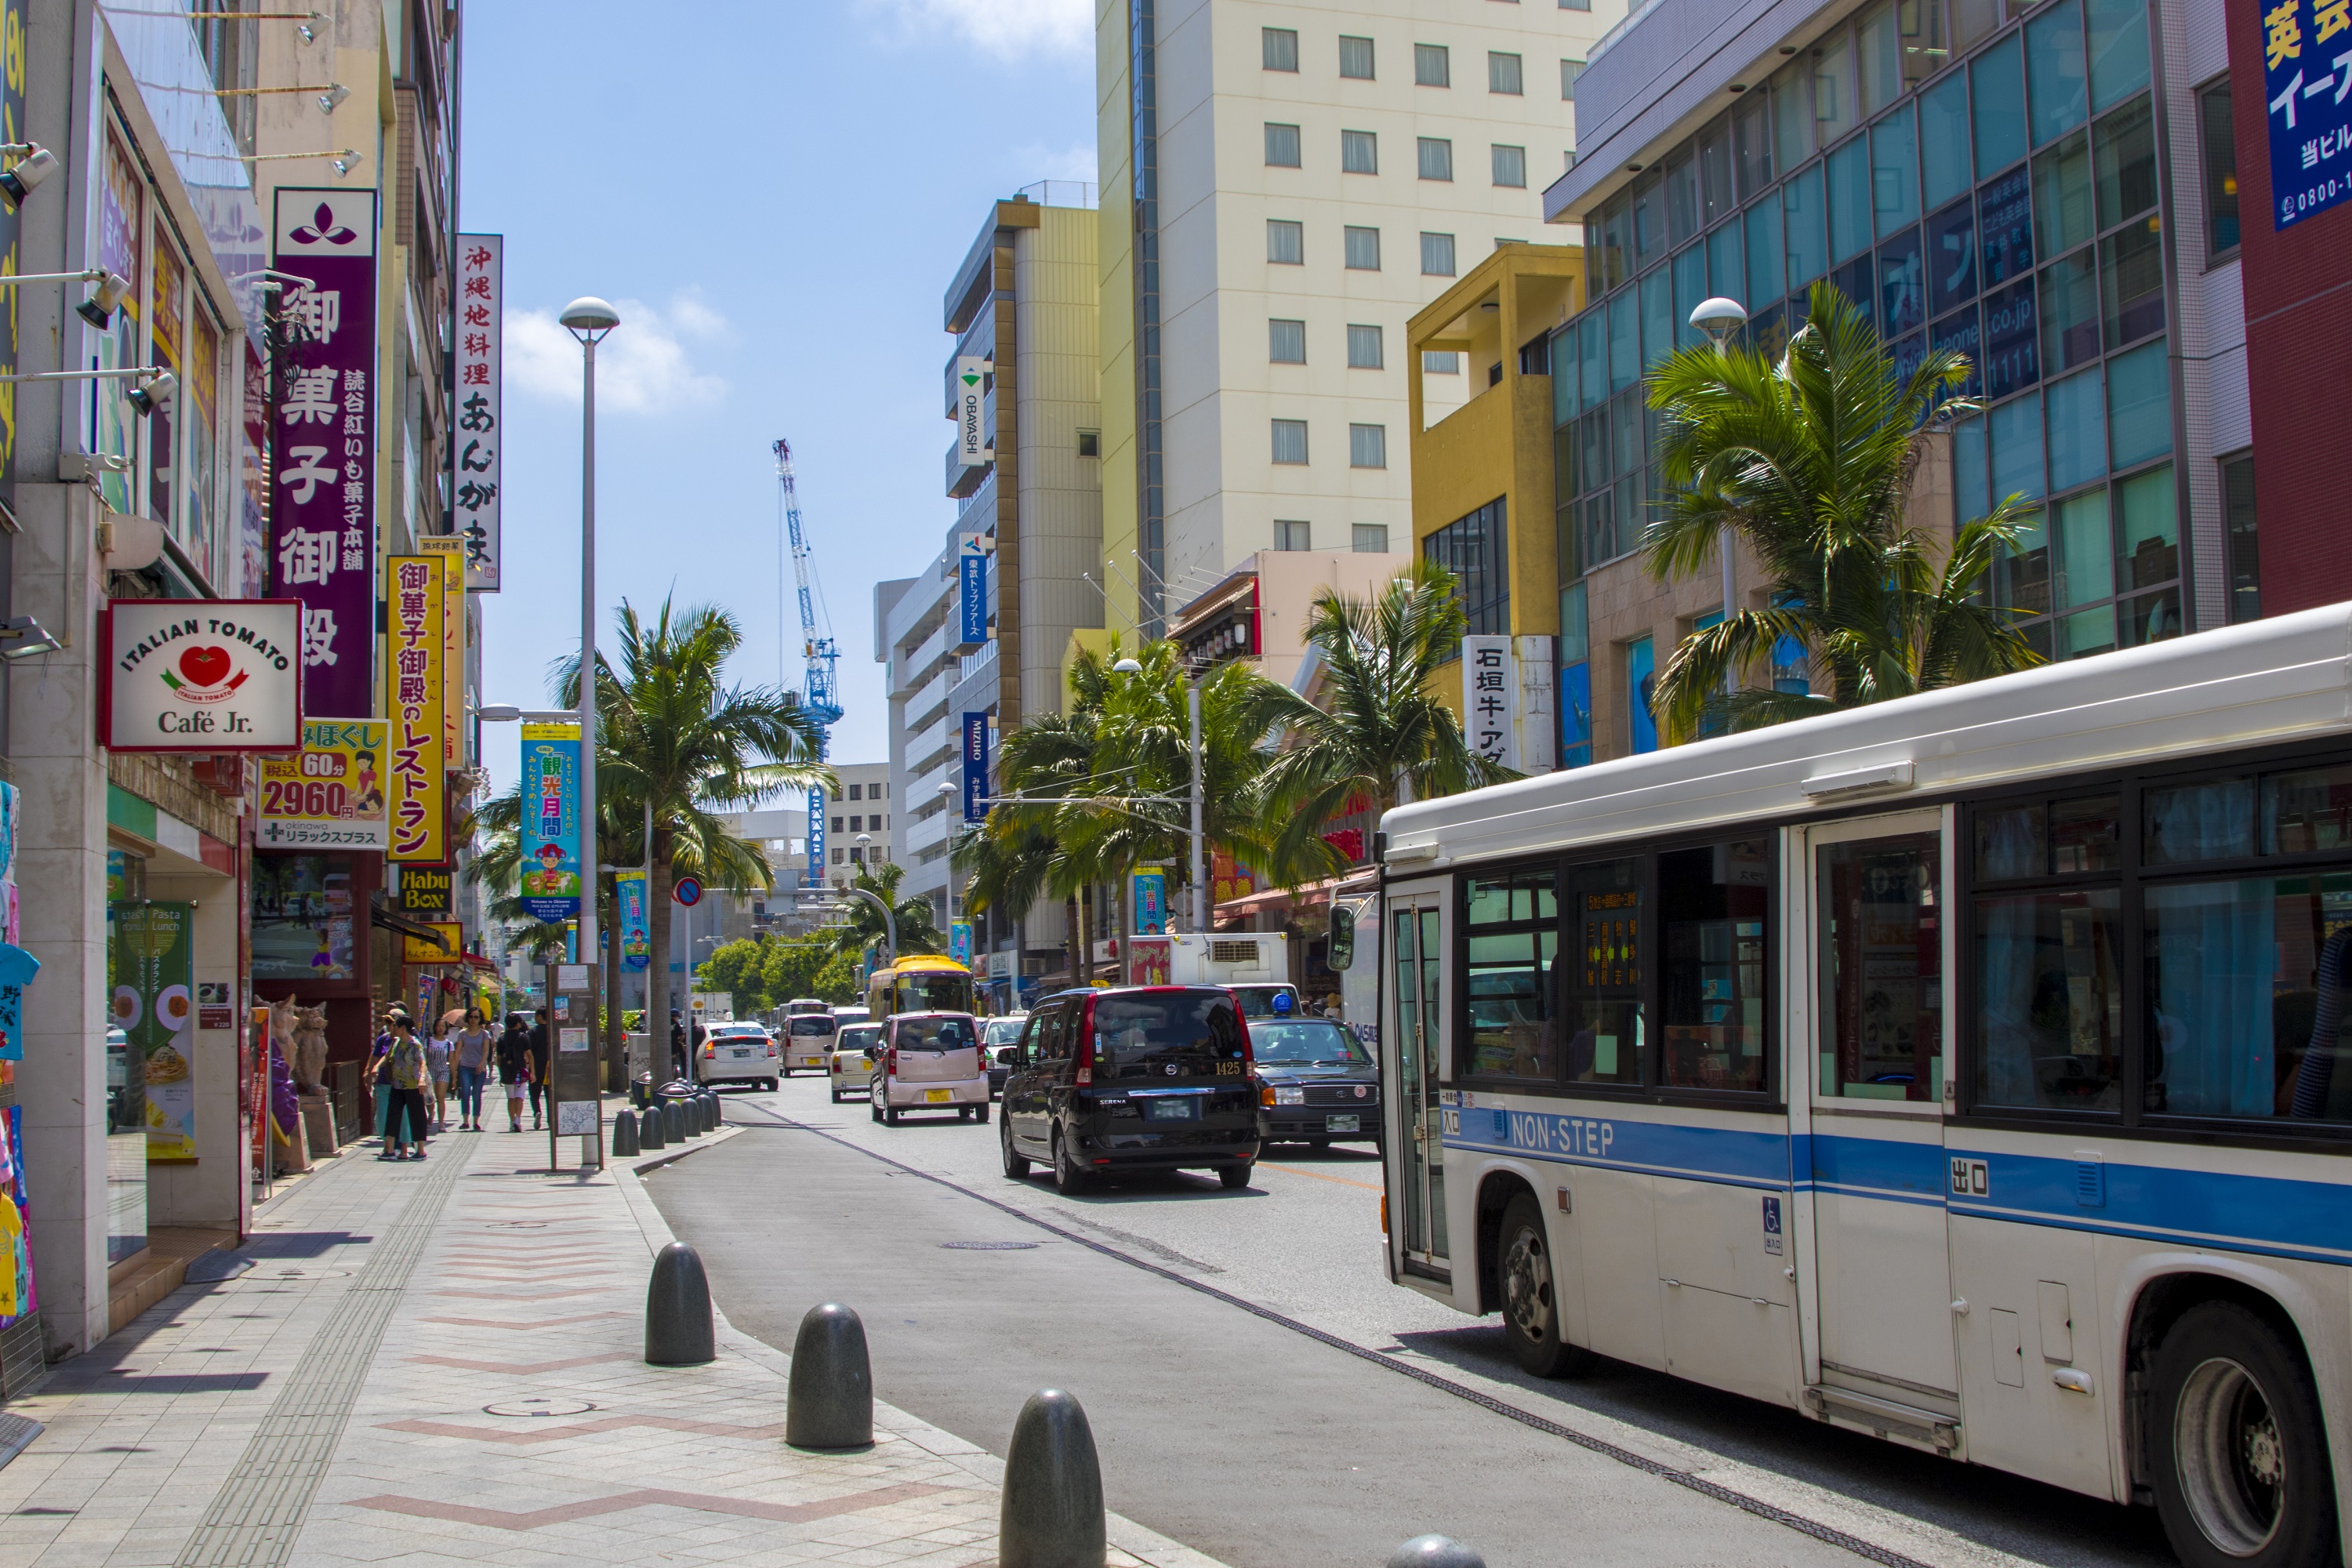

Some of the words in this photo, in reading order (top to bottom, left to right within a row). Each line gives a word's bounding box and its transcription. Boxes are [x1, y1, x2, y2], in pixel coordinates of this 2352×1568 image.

[463, 245, 493, 386] 沖縄地料理
[966, 395, 978, 454] OBAYASHI
[343, 368, 365, 572] 読谷紅いも菓子本舗
[456, 390, 498, 567] あんがま
[968, 559, 981, 636] 東武トップツアーズ
[119, 619, 199, 673] ITALIAN
[209, 619, 289, 671] TOMATO
[177, 690, 203, 701] ITALIAN
[205, 690, 232, 701] TOMATO
[394, 561, 431, 855] 御菓子御殿のレストラン
[158, 711, 215, 733] Café
[223, 711, 253, 734] Jr.
[972, 720, 982, 761] MIZUHO
[265, 764, 299, 778] 税込
[304, 754, 345, 776] 60分
[263, 781, 354, 821] 2960円
[285, 822, 328, 831] okinawa
[286, 831, 377, 844] リラックスプラス
[401, 871, 449, 889] Habu
[405, 890, 445, 909] Box
[151, 920, 180, 931] Lunch
[152, 909, 181, 920] Pasta
[152, 948, 162, 994] パスタランチ
[1214, 1062, 1241, 1076] 1425
[1443, 1110, 1461, 1134] 入口
[1952, 1159, 1987, 1196] 出口
[1766, 1237, 1781, 1250] 出入口
